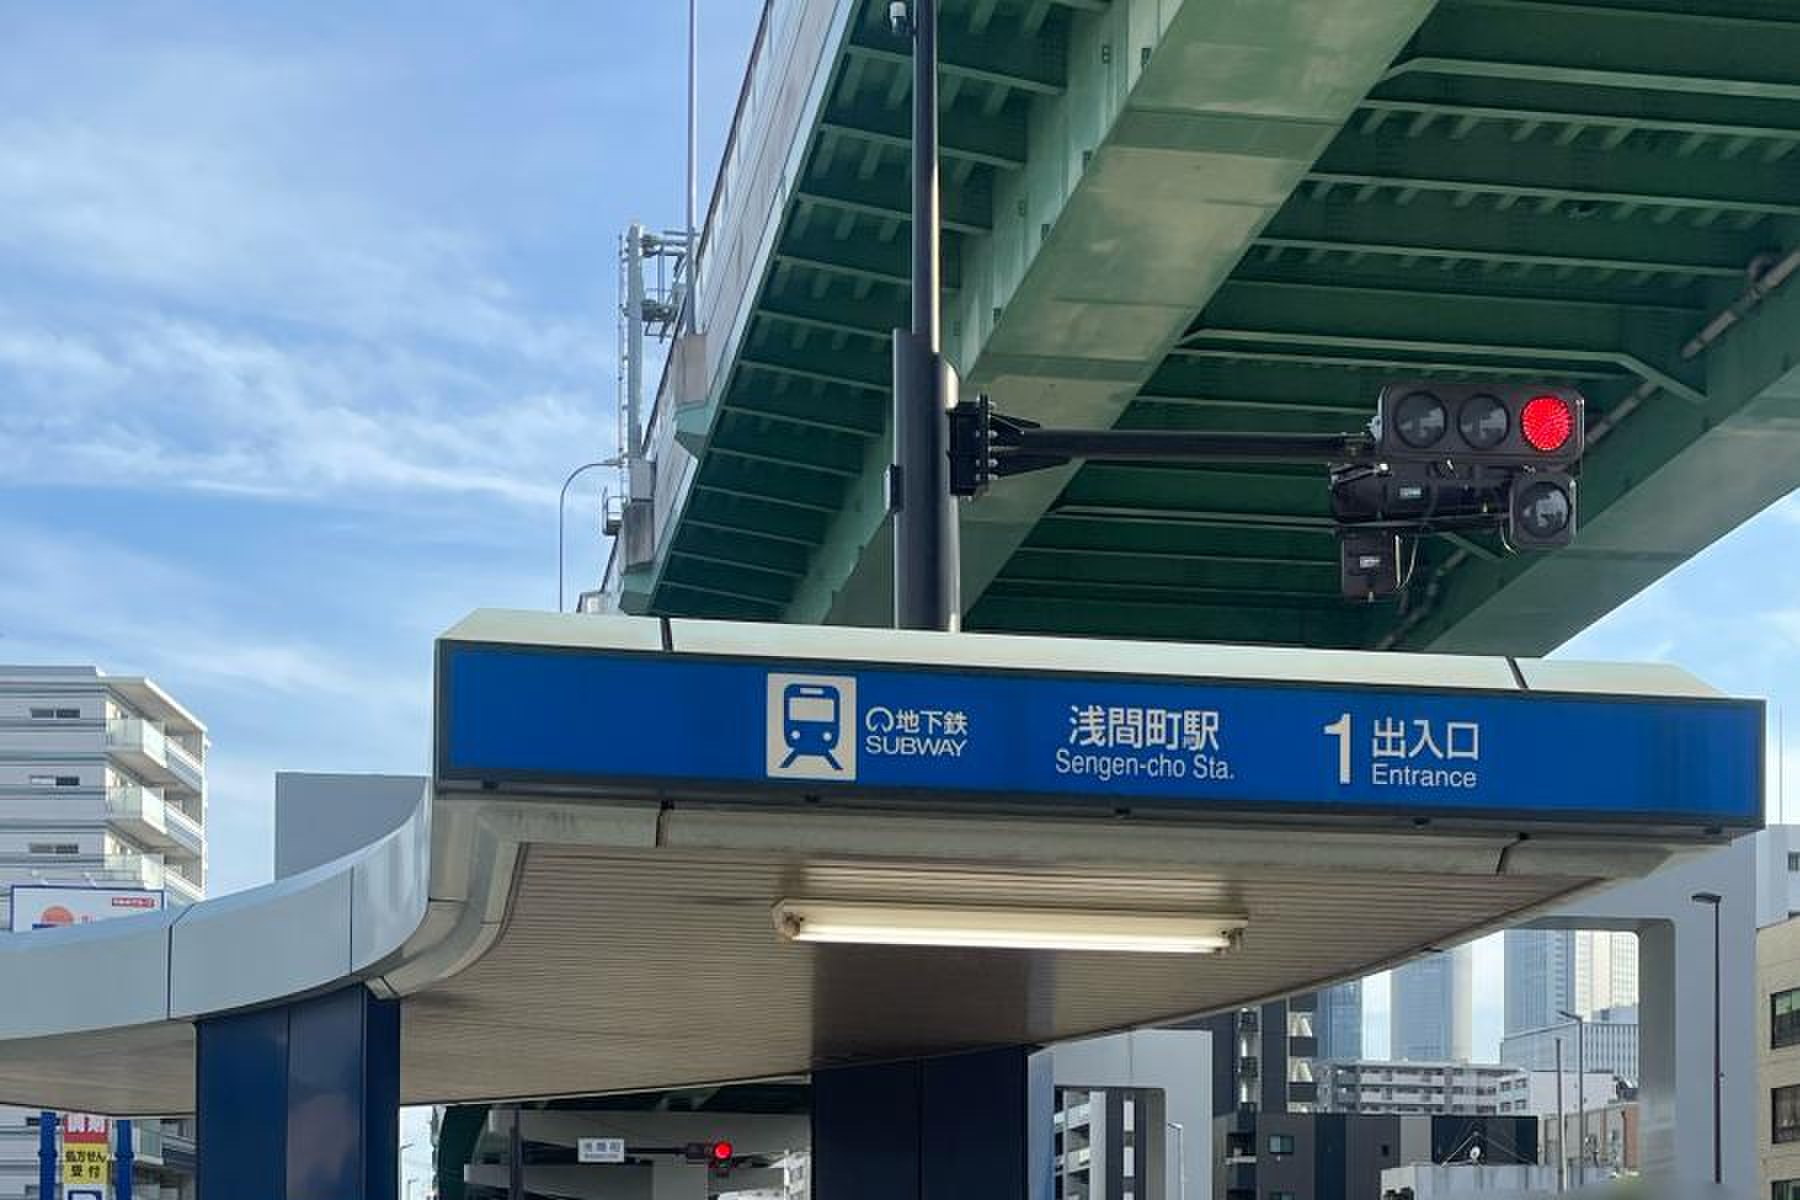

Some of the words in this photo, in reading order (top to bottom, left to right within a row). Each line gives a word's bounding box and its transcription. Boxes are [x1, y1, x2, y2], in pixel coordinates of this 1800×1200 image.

[896, 709, 968, 736] 地下鉄
[1069, 705, 1219, 751] 浅間町駅
[865, 735, 968, 757] SUBWAY
[1323, 712, 1351, 785] 1
[1371, 717, 1479, 760] 出入口
[1055, 748, 1186, 781] Sengen-cho
[1192, 754, 1235, 780] Sta.
[1371, 763, 1477, 788] Entrance
